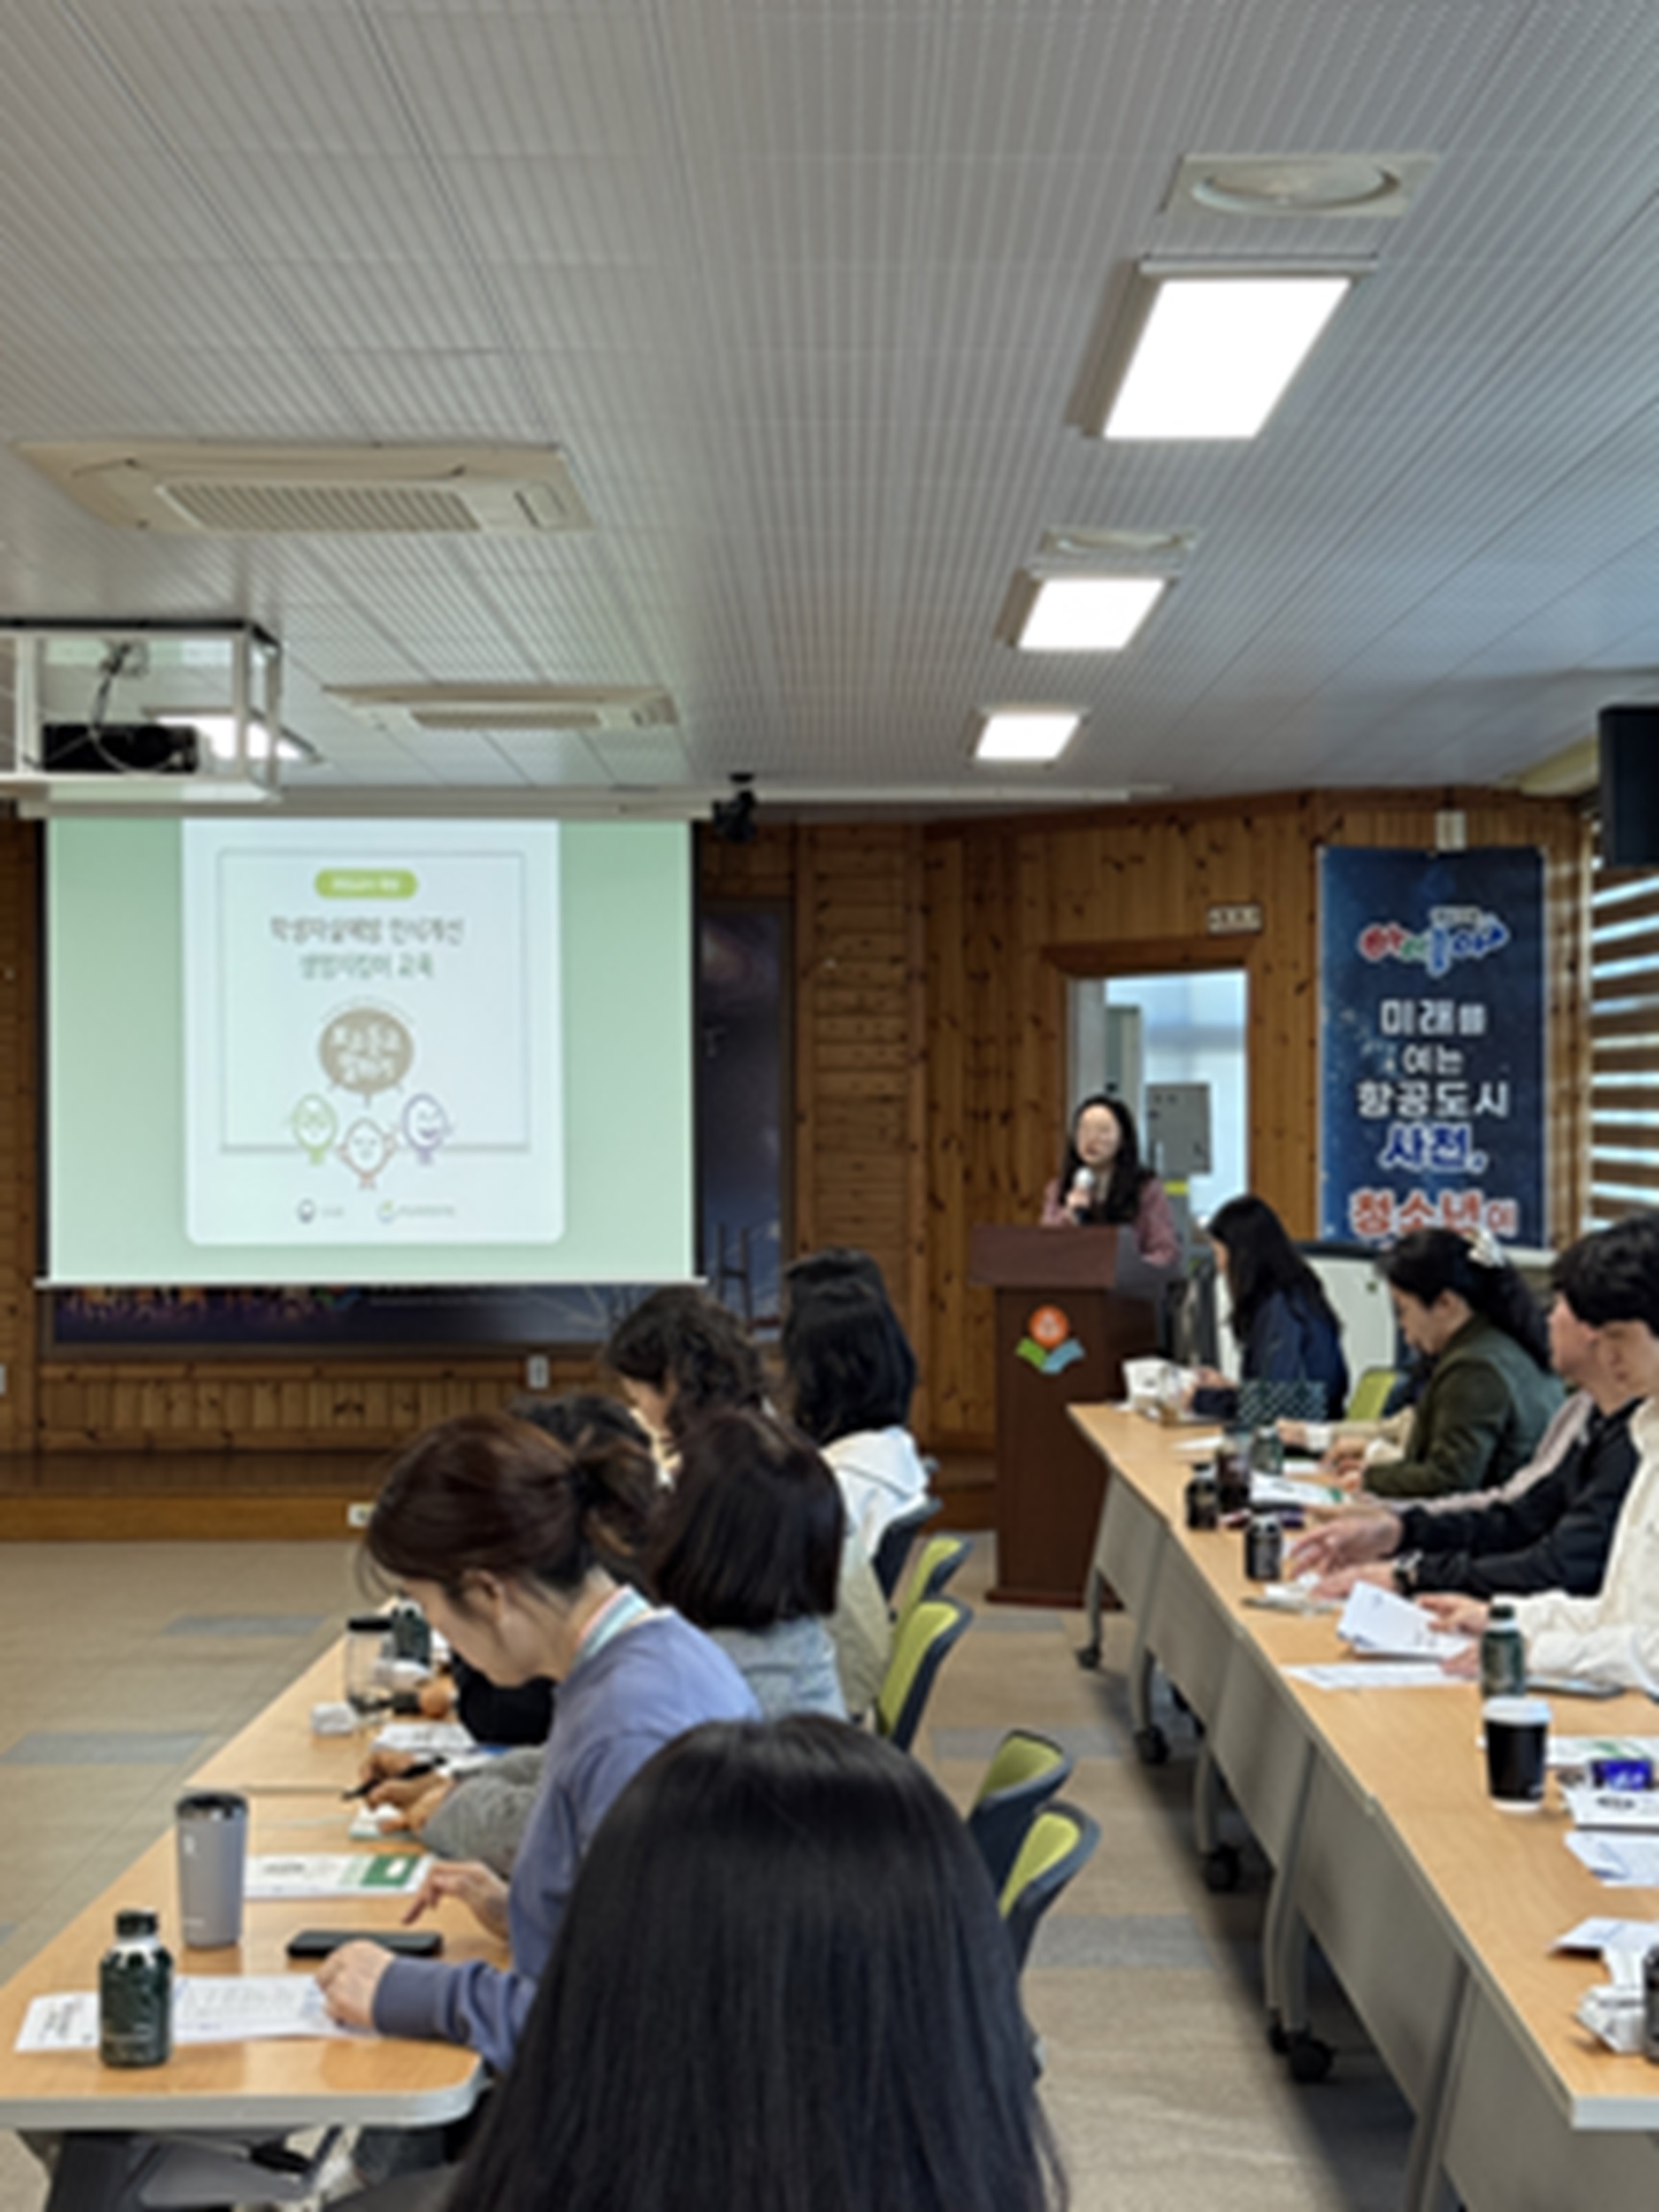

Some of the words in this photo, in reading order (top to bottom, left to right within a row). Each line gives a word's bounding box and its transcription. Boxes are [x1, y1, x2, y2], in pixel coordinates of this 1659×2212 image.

[1380, 999, 1486, 1036] 미래를
[1402, 1044, 1463, 1075] 여는
[1356, 1080, 1509, 1118] 항공도시
